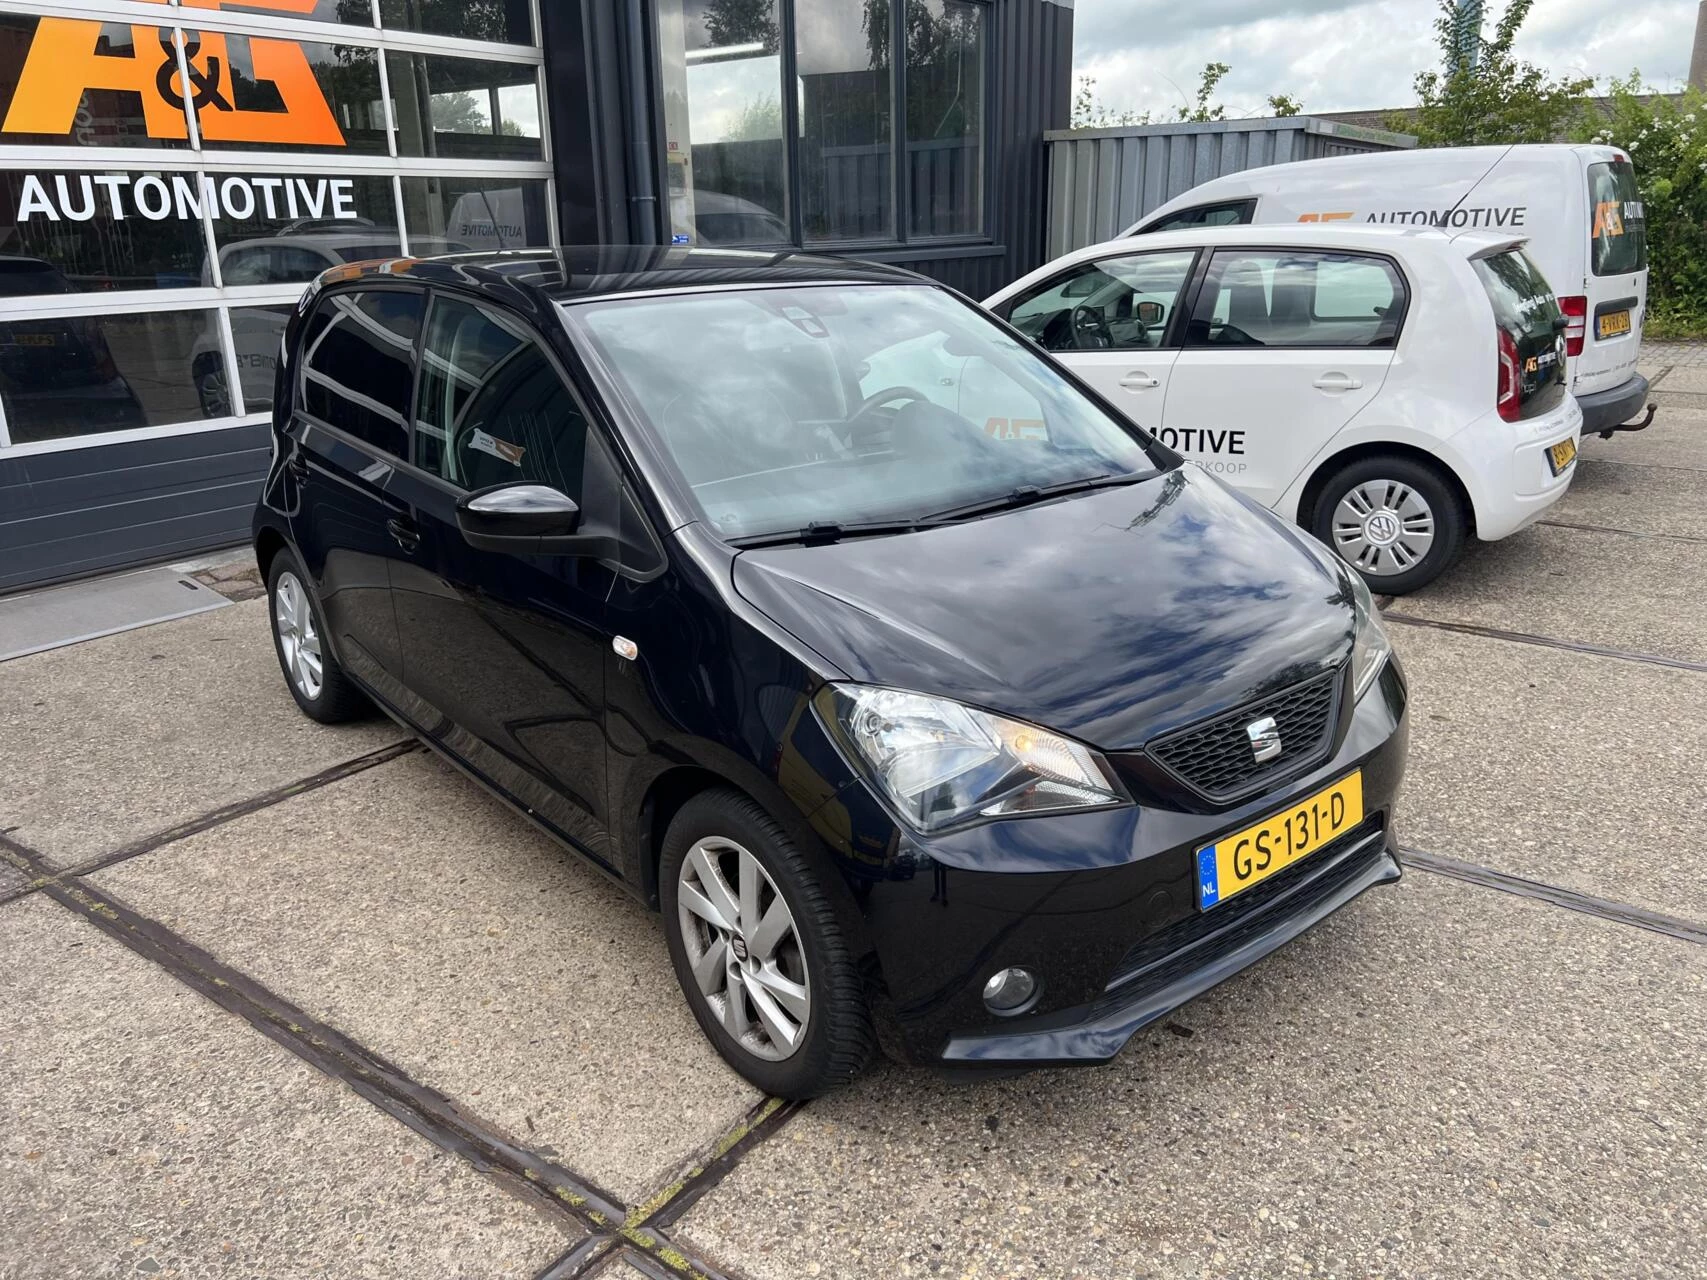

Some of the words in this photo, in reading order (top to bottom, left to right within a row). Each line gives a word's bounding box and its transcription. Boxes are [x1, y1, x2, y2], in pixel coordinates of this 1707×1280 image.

[17, 174, 358, 222] AUTOMOTIVE
[1149, 427, 1245, 455] OTIVE
[1233, 791, 1345, 881] GS-131-D
[1202, 882, 1216, 897] NL
